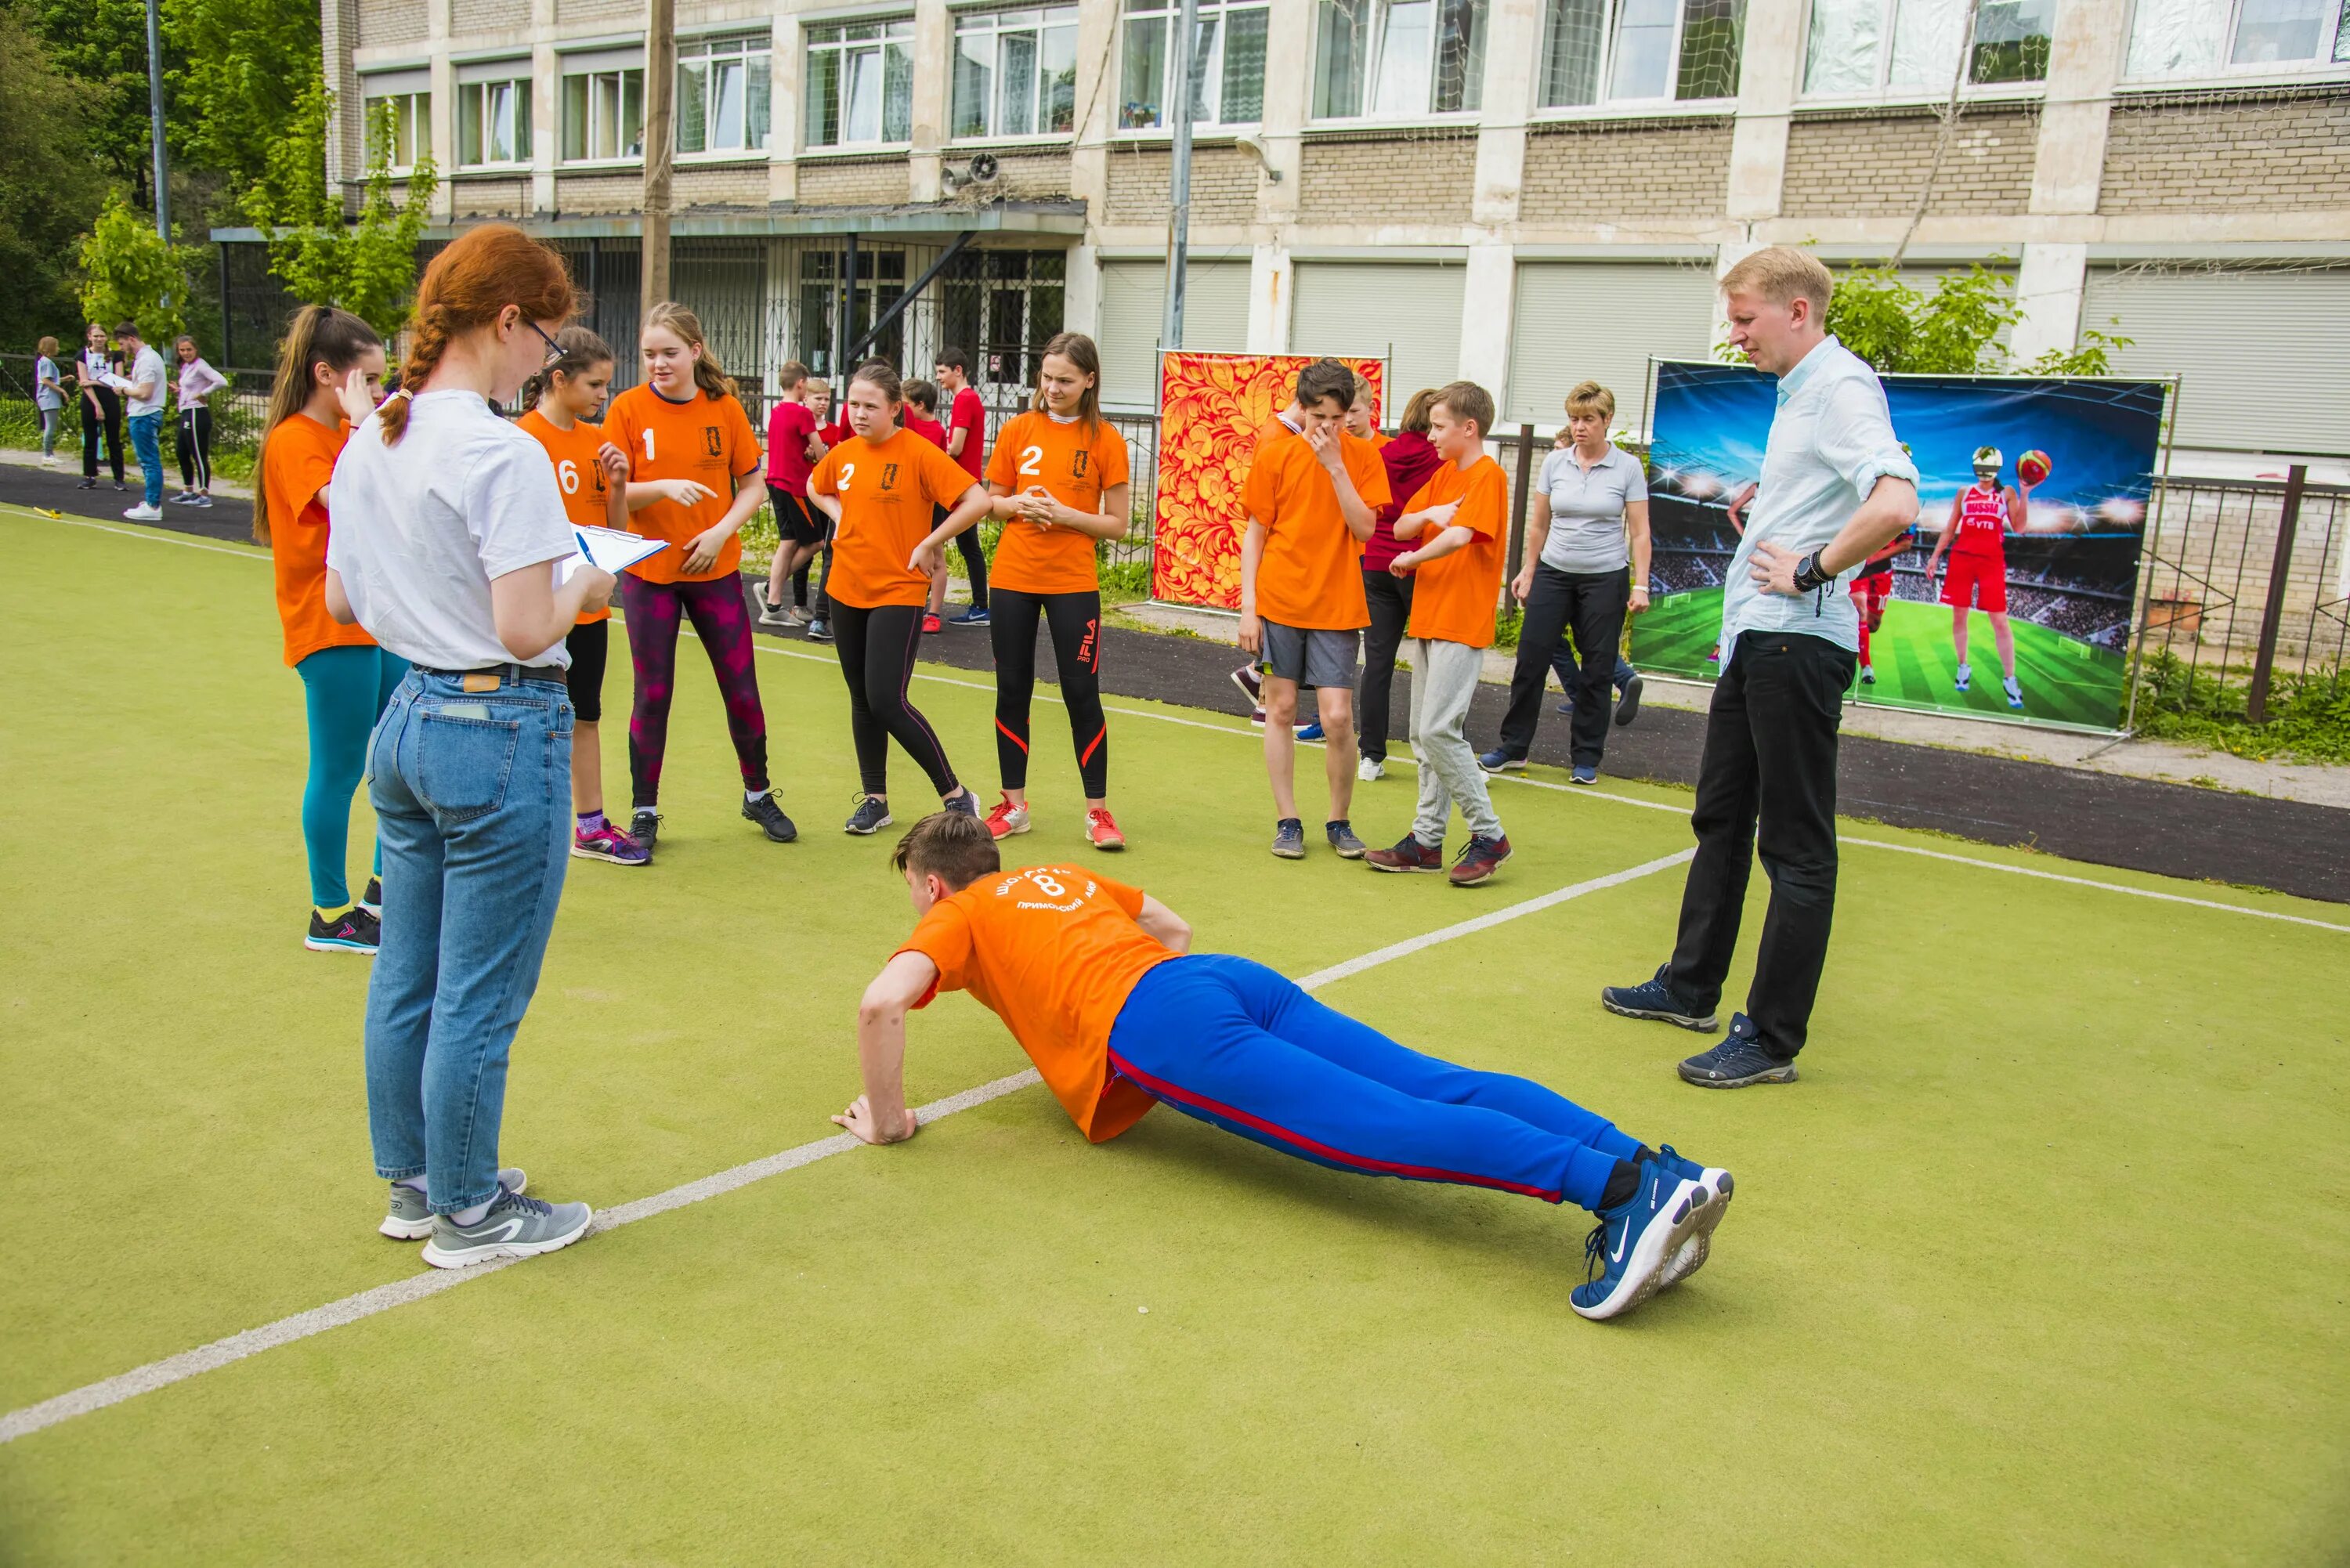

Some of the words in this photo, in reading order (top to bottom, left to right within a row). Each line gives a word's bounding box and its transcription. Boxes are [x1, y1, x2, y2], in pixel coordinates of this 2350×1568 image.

[642, 428, 655, 461] 1
[1019, 445, 1043, 476] 2
[558, 459, 580, 495] 6
[837, 463, 855, 491] 2
[1987, 493, 2001, 502] 17
[1976, 520, 1994, 530] VTB
[1079, 619, 1097, 657] FILA
[1032, 875, 1065, 897] 8
[1017, 898, 1084, 912] ПРИМОСКИЙ
